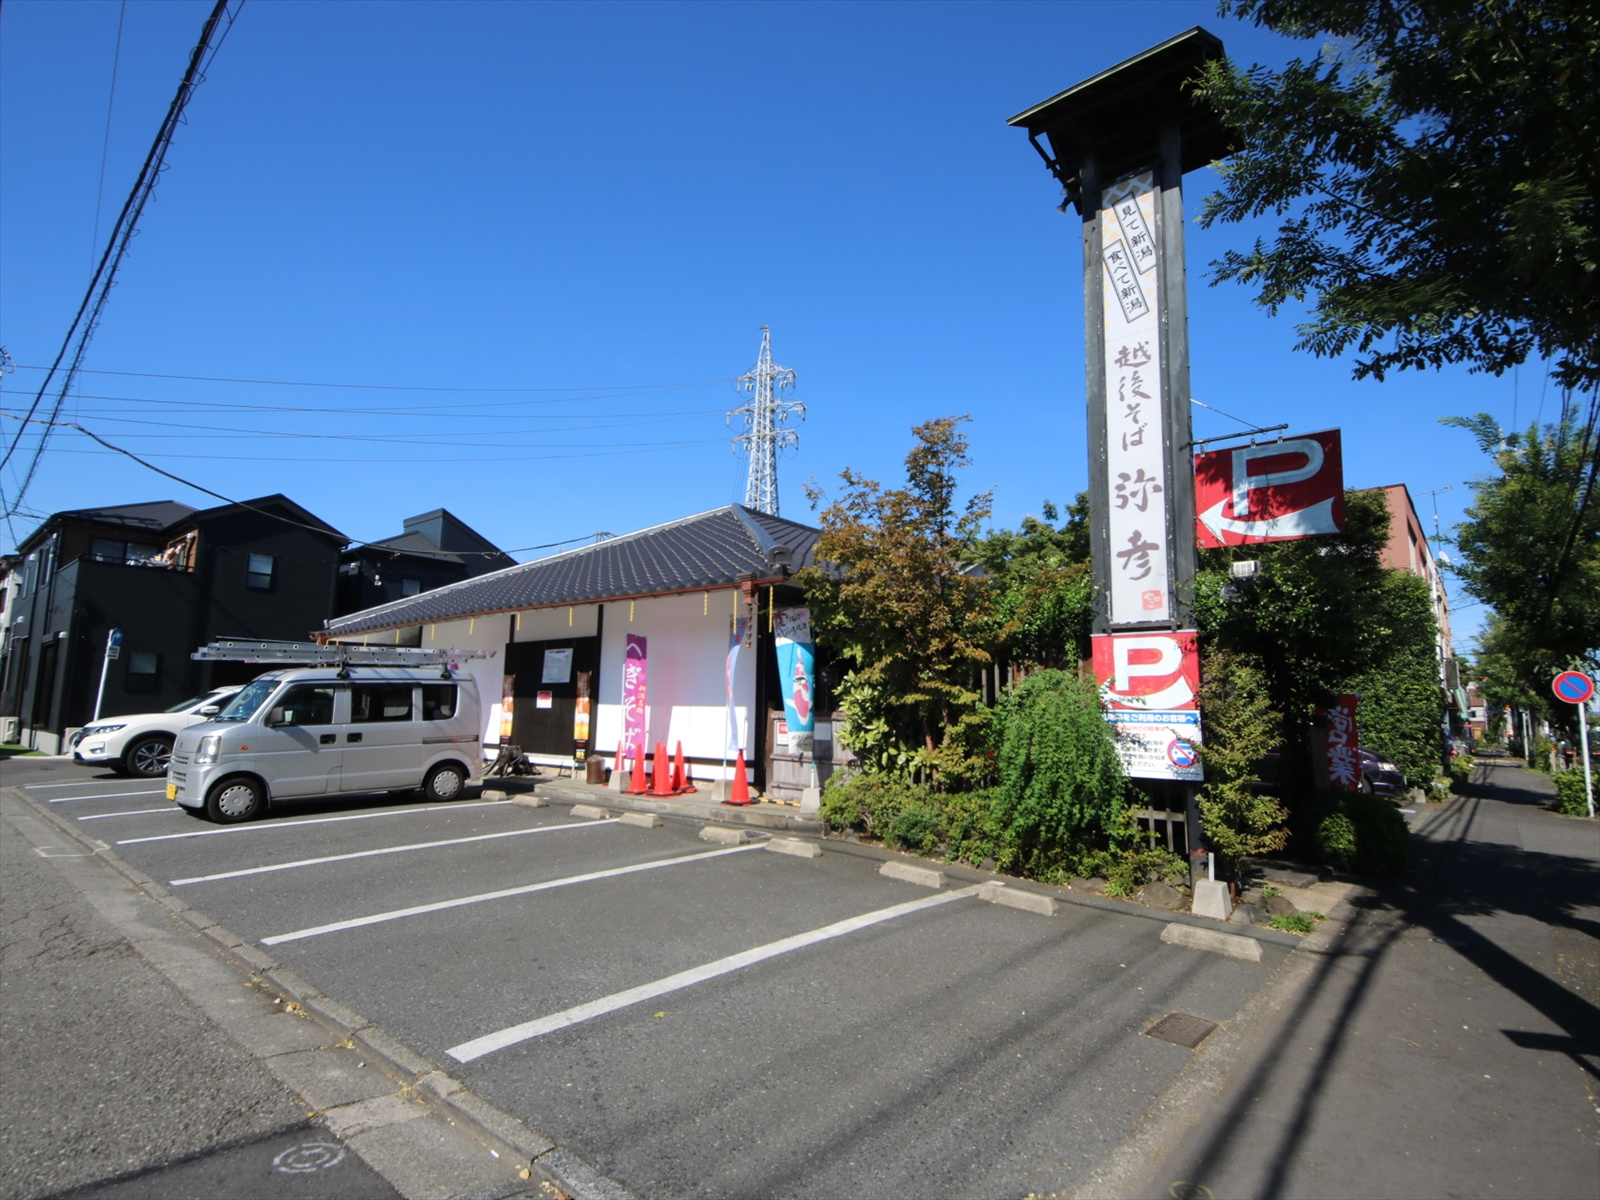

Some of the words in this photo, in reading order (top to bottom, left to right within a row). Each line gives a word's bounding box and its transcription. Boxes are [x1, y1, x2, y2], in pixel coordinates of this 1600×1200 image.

[1121, 204, 1153, 262] 見て新潟
[1107, 250, 1143, 313] 食べて新潟
[1114, 341, 1152, 451] 越後そば
[1232, 439, 1324, 517] P
[1114, 468, 1162, 581] 弥彦
[1113, 636, 1183, 691] P
